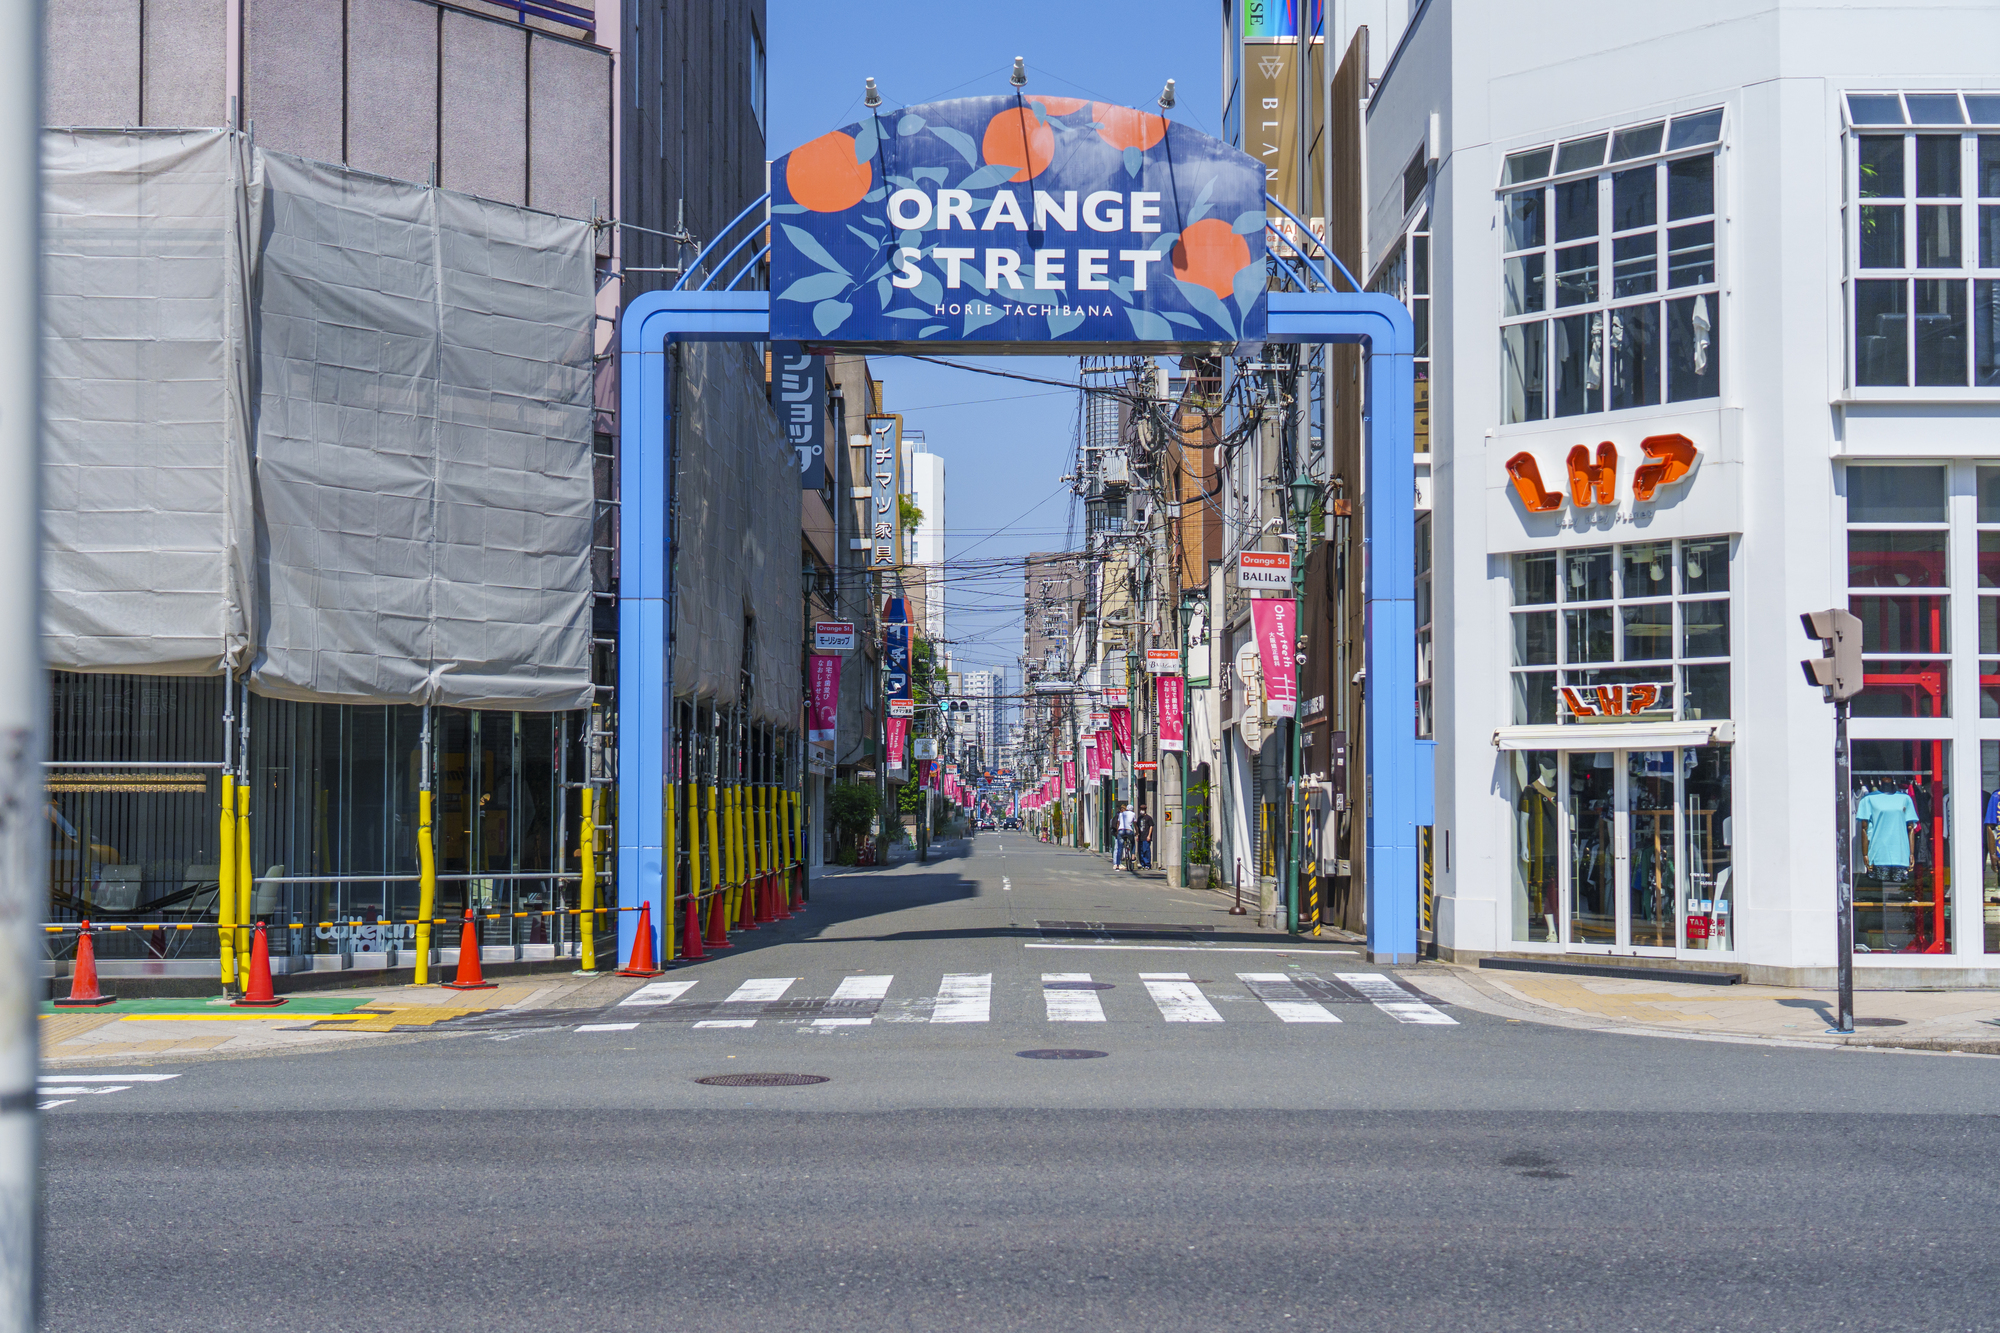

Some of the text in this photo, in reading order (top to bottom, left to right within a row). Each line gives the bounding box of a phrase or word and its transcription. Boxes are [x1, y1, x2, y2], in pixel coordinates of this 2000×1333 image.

[886, 188, 1162, 233] ORANGE
[892, 247, 1162, 291] STREET
[934, 303, 1114, 317] HORIE TACHIBANA
[1505, 432, 1699, 514] LHP
[874, 421, 894, 565] イチマツ家具
[1242, 572, 1287, 583] BALILax
[1243, 556, 1288, 567] Orange St.
[818, 625, 843, 633] Orange
[819, 636, 851, 646] モーリショップ
[1274, 604, 1293, 668] Oh my teeth
[822, 659, 833, 700] 自宅で歯並び
[1170, 680, 1179, 716] 自宅で歯並び
[1561, 683, 1662, 718] LHP
[1133, 761, 1157, 770] Supreme
[1690, 919, 1705, 927] TAX
